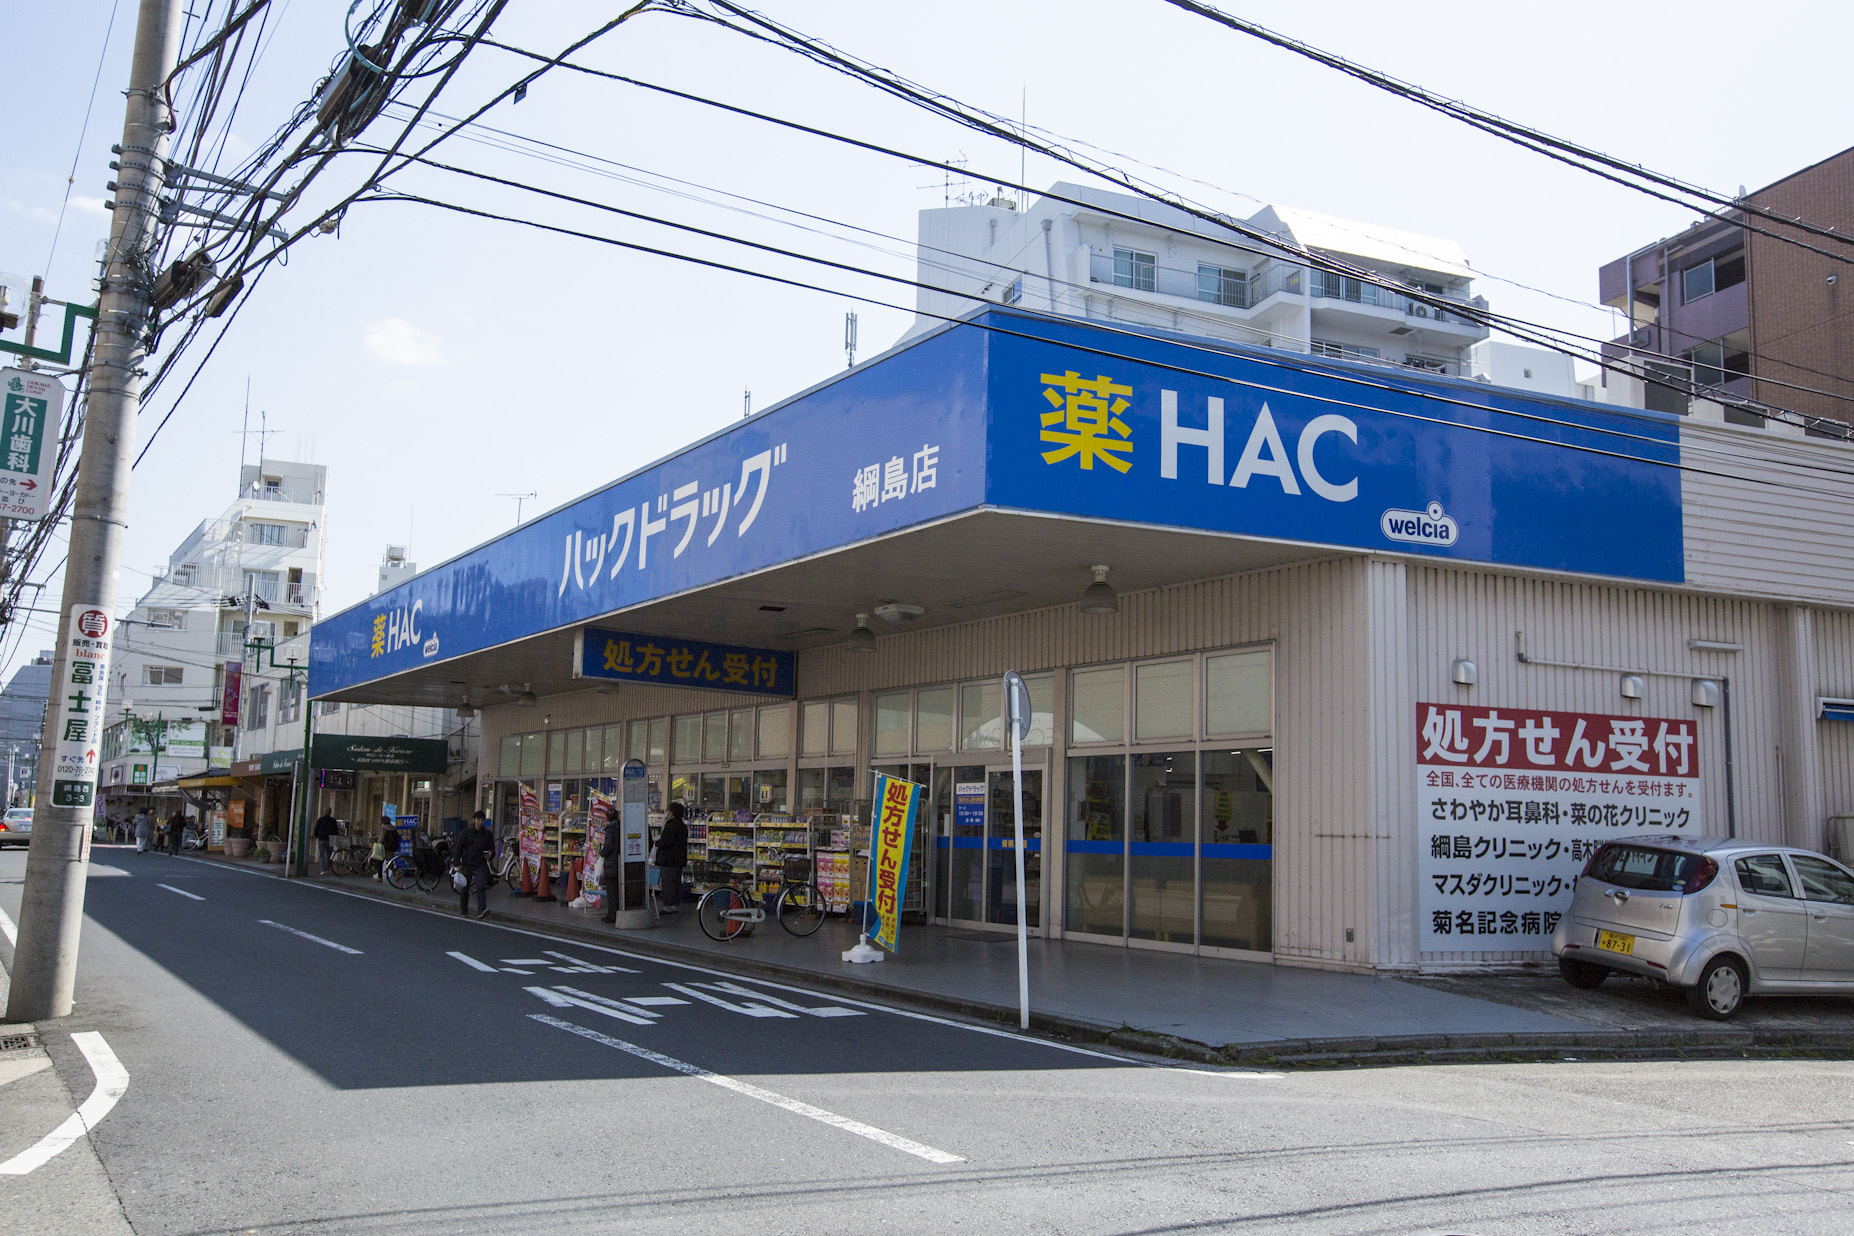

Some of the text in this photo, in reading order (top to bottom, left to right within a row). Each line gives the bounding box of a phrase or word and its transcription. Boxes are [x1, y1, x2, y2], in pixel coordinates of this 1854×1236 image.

[27, 384, 46, 392] DENTAL
[7, 397, 38, 473] 大川歯科
[1040, 370, 1358, 502] 薬 HAC
[558, 442, 940, 598] ハックドラッグ 綱島店
[1388, 516, 1450, 540] welcia
[82, 613, 105, 636] 質
[371, 599, 423, 659] 薬 HAC
[76, 649, 105, 659] blanc
[602, 638, 778, 688] 処方せん受付
[1421, 706, 1694, 775] 処方せん受付
[61, 755, 85, 764] すぐ先
[1426, 770, 1693, 798] 全国、全ての医療機関の処方せんを受付ます。
[1431, 798, 1690, 828] さわやか耳鼻科・菜の花クリニック
[878, 782, 908, 915] 処方せん受付
[1432, 910, 1562, 935] 菊名記念病院
[1606, 939, 1631, 953] 87-31
